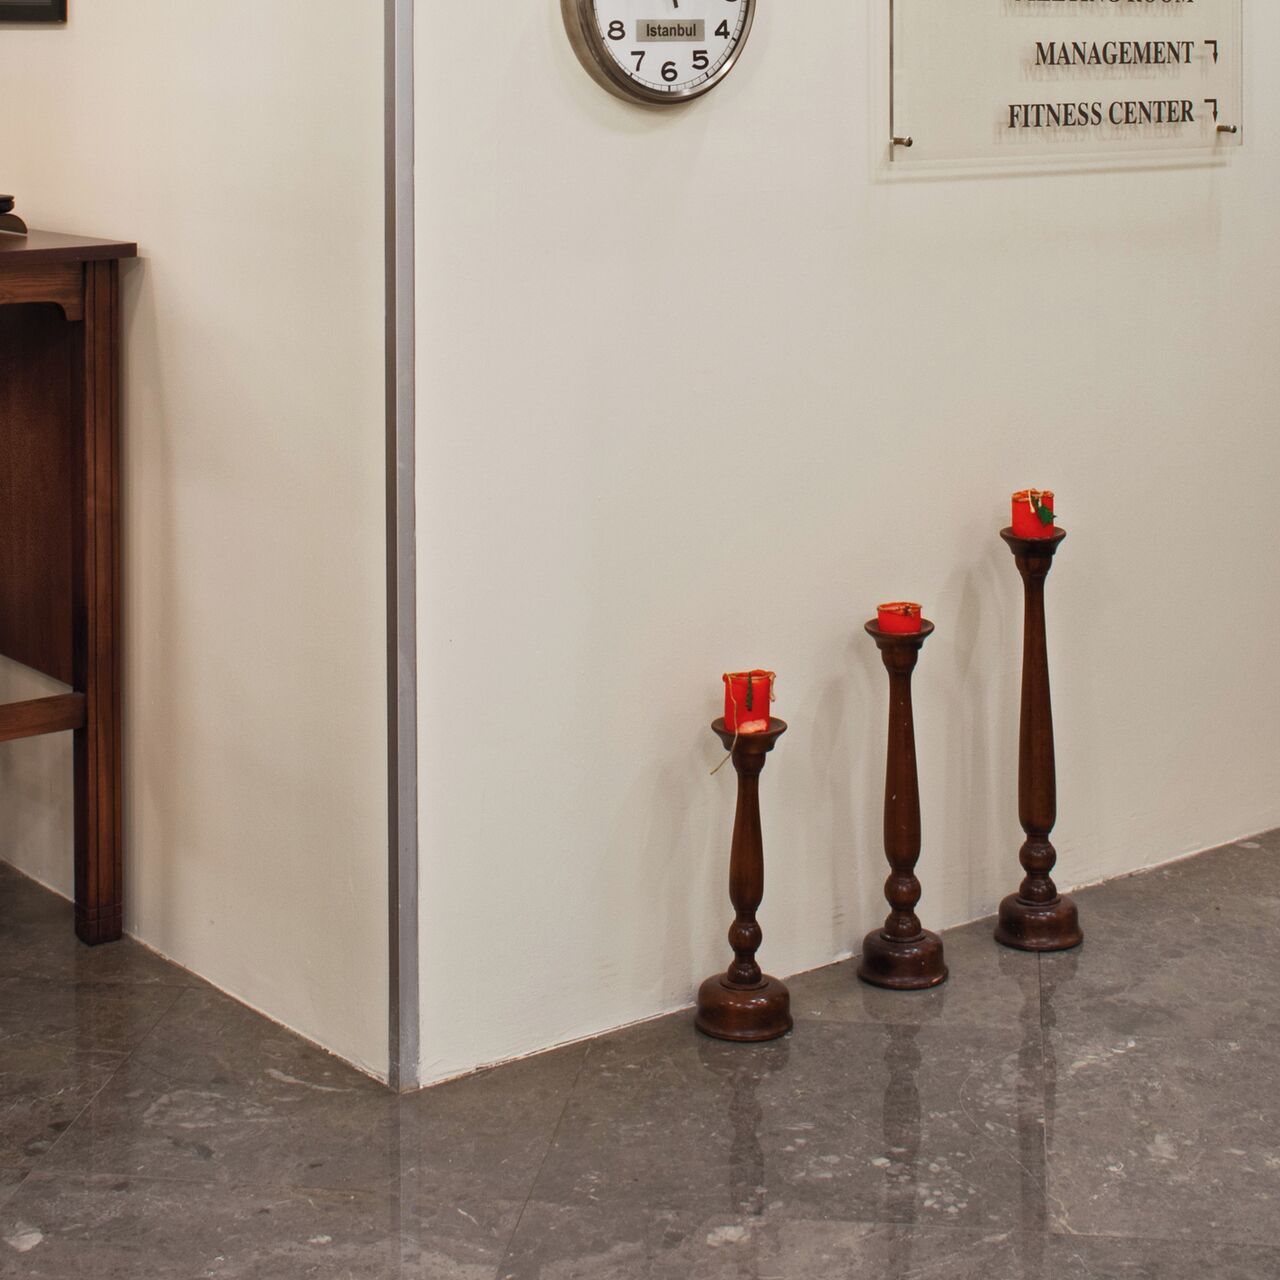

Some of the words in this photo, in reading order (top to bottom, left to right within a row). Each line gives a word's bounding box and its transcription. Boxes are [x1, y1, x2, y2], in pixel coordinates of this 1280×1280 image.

[607, 20, 626, 40] 8
[646, 23, 696, 37] Istanbul
[714, 20, 730, 39] 4
[631, 51, 645, 71] 7
[692, 50, 709, 70] 5
[1035, 41, 1194, 65] MANAGEMENT
[661, 61, 678, 82] 6
[1008, 101, 1102, 128] FITNESS
[1108, 99, 1194, 125] CENTER
